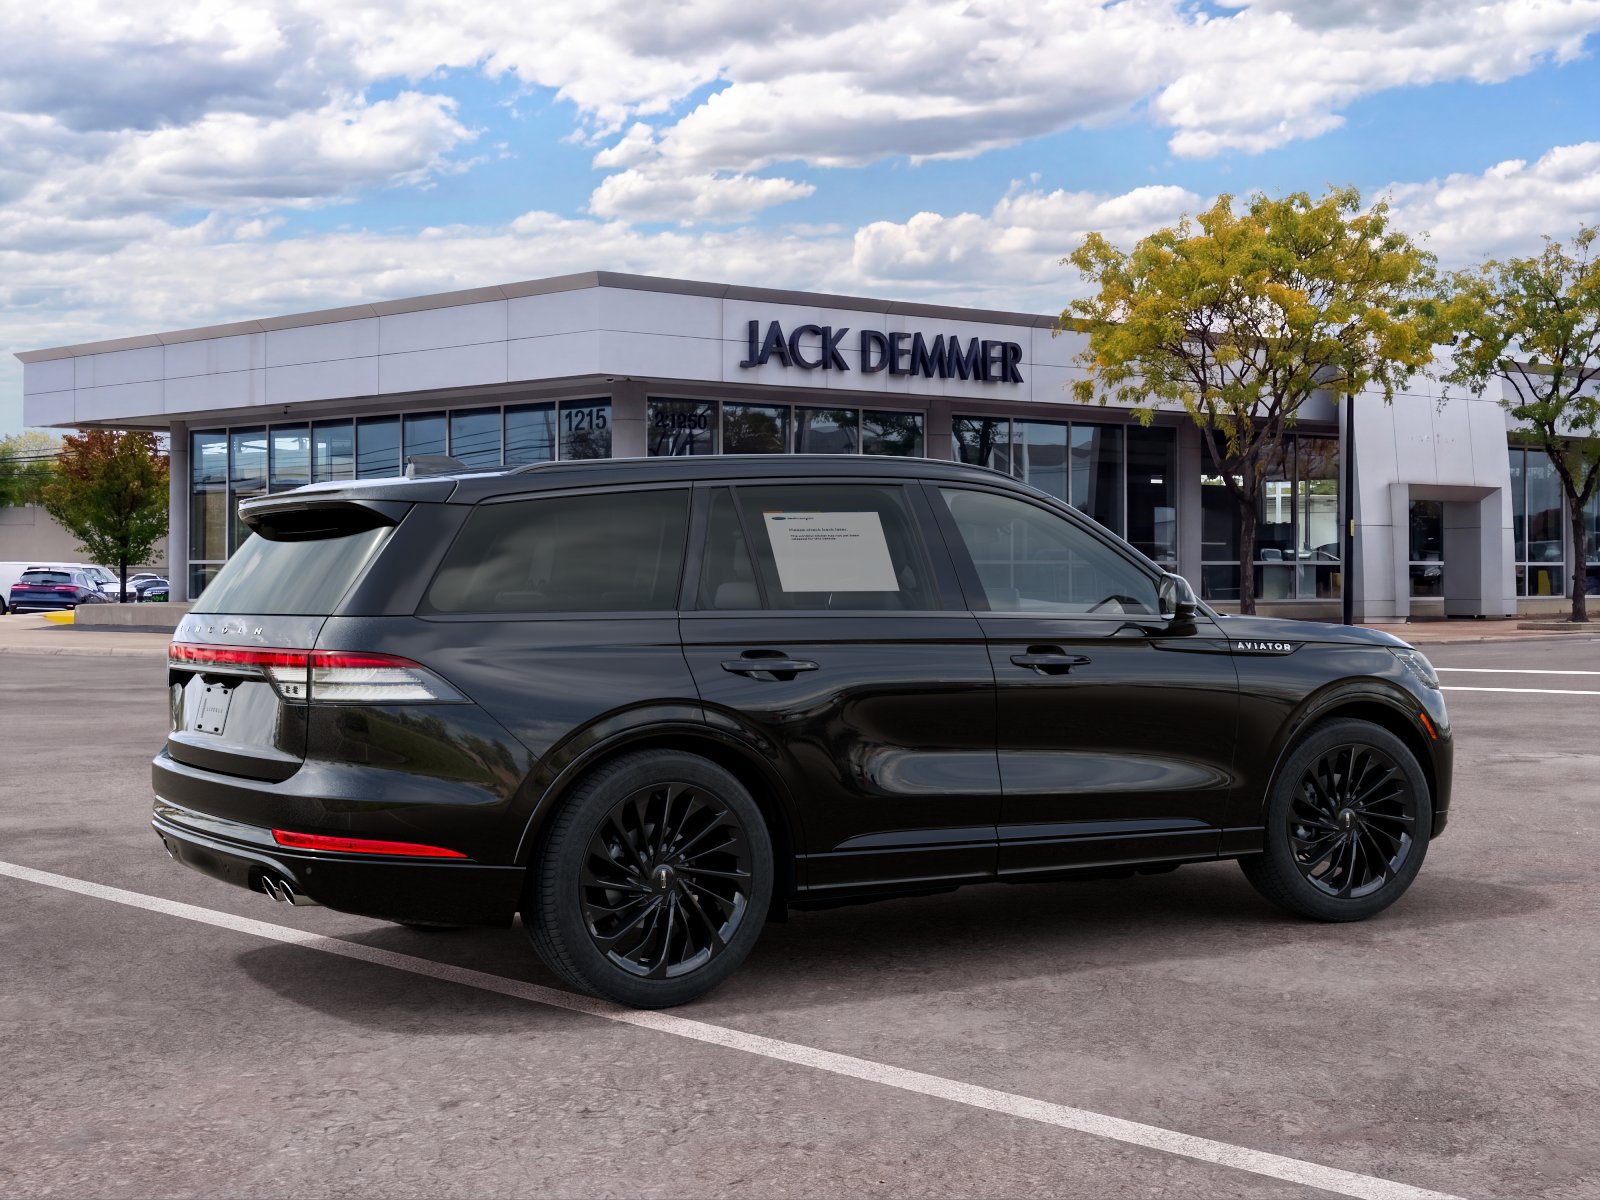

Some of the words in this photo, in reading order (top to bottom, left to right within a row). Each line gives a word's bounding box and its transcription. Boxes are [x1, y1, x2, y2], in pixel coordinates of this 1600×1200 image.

[739, 320, 850, 371] JACK
[860, 329, 1024, 384] DEMMER
[565, 408, 607, 432] 1215
[178, 625, 263, 635] LINCOLN
[1237, 641, 1291, 651] AVIATOR
